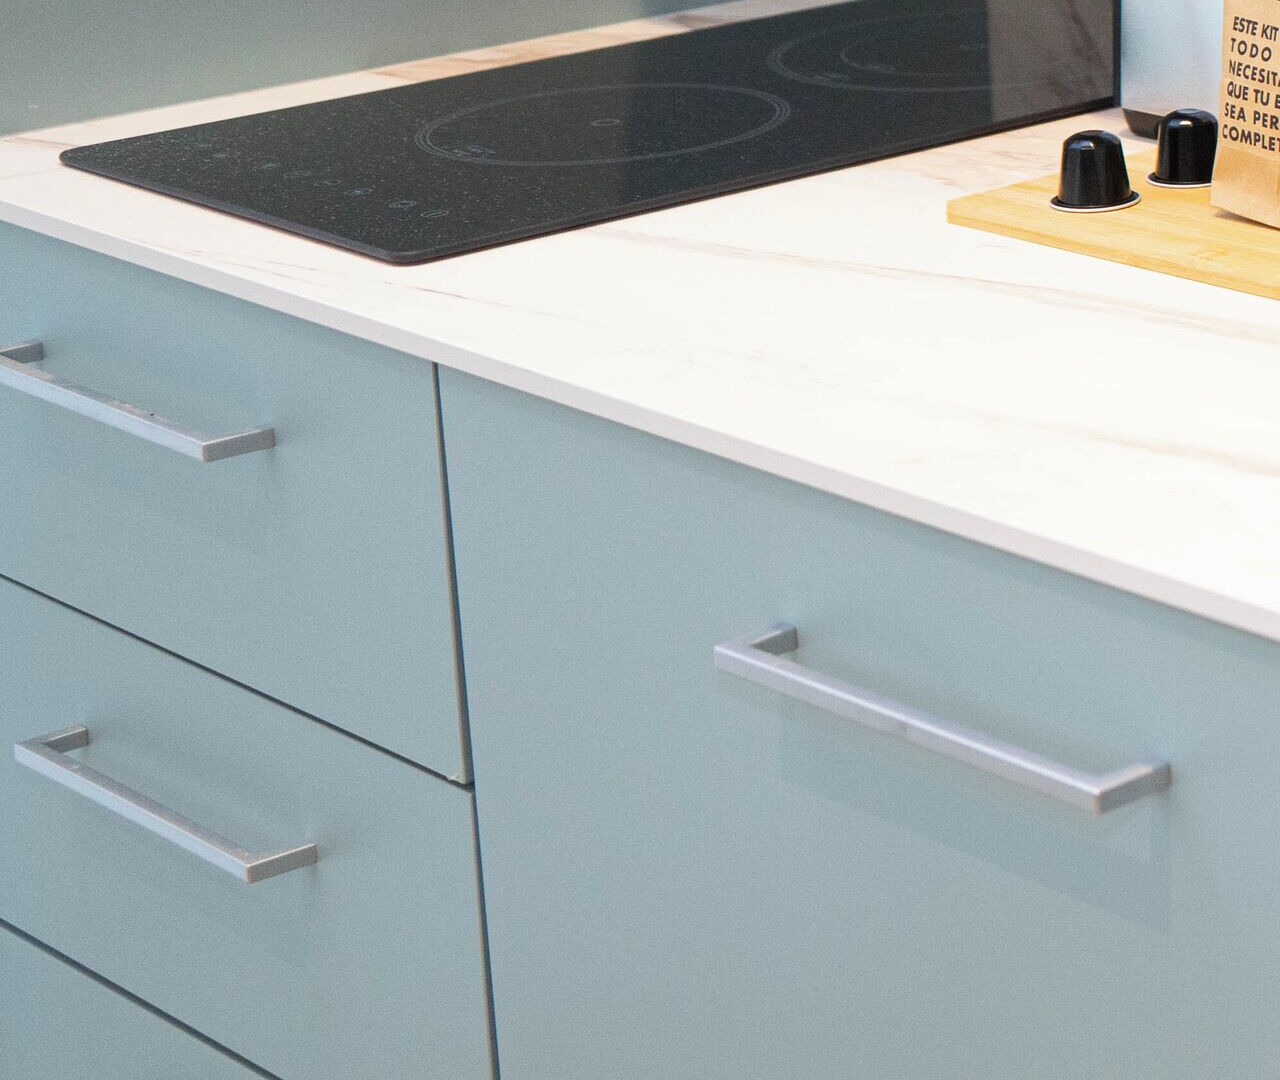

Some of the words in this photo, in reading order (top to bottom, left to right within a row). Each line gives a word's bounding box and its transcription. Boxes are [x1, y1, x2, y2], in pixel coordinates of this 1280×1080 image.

[1233, 16, 1258, 36] ESTE
[1261, 24, 1279, 42] KIT
[1230, 38, 1272, 62] TODO
[1227, 81, 1249, 101] QUE
[1253, 88, 1270, 106] TU
[1224, 102, 1246, 123] SEA
